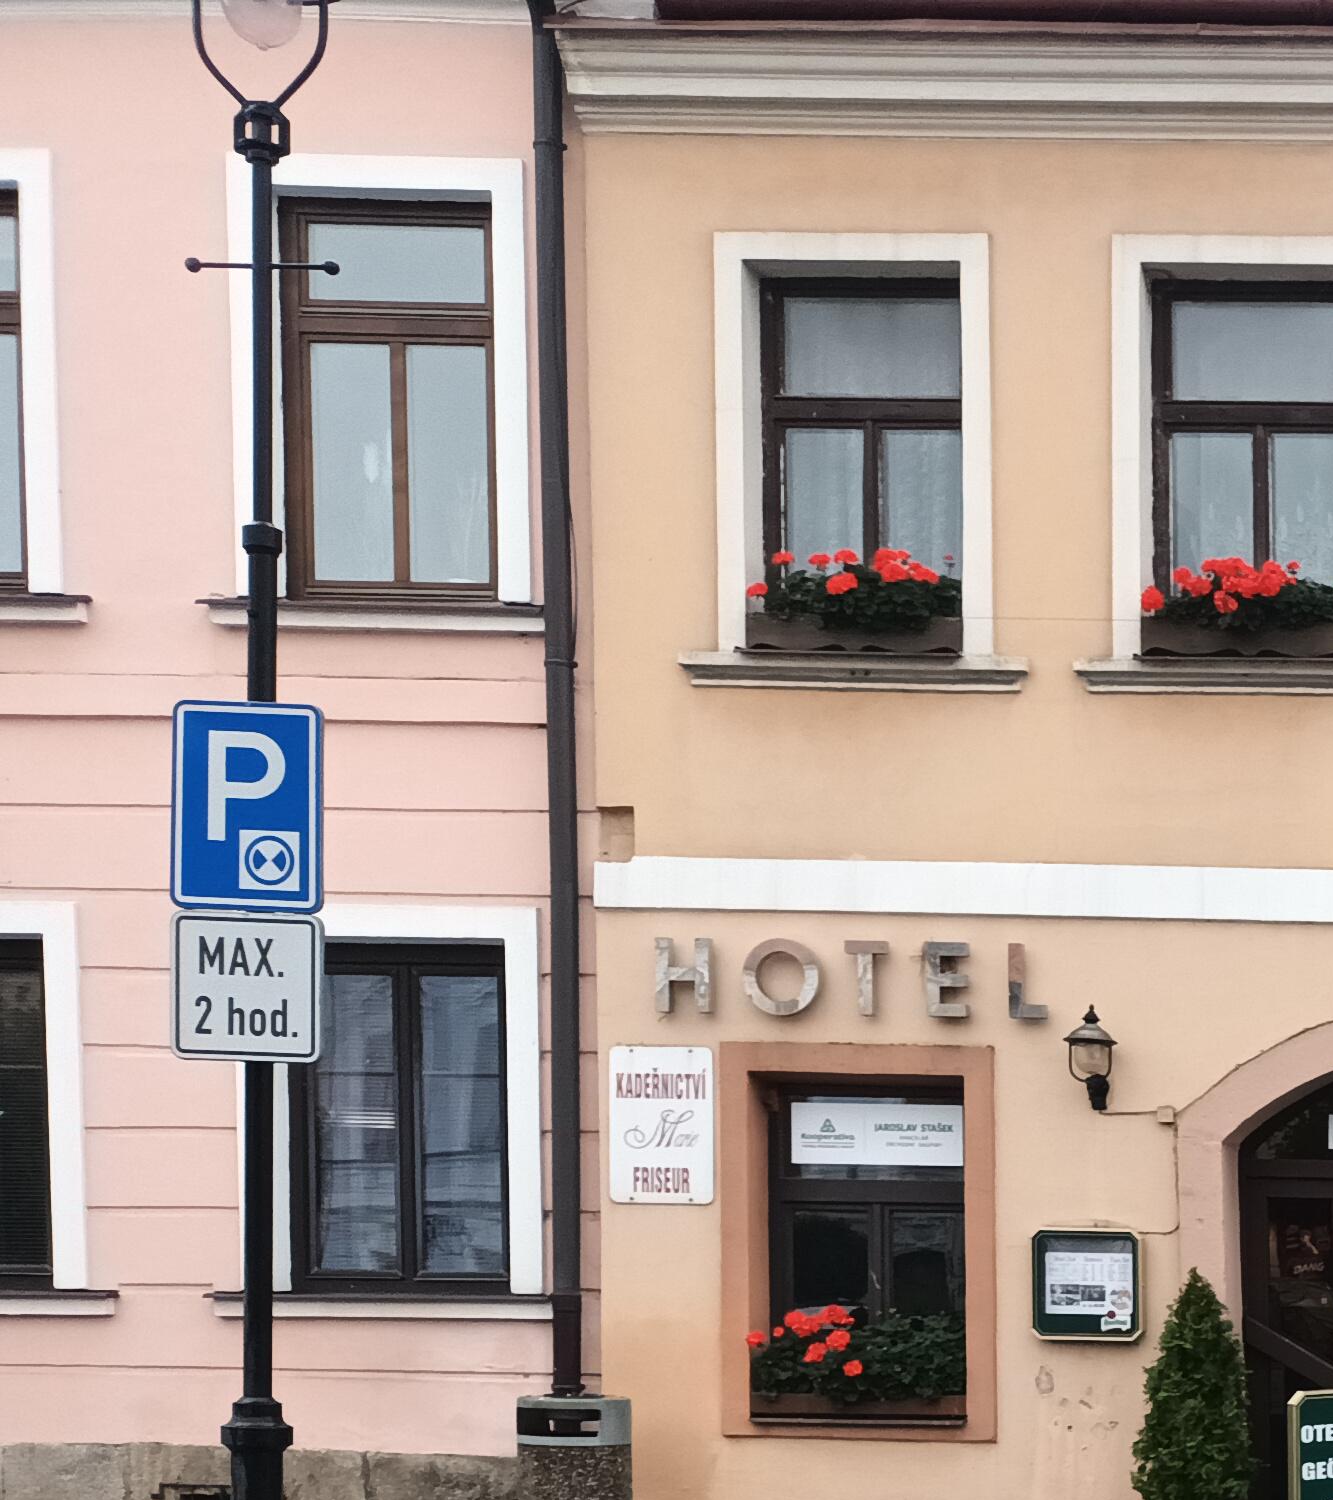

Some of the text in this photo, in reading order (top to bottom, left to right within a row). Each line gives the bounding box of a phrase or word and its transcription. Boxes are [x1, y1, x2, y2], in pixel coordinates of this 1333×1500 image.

[207, 729, 286, 841] P
[198, 935, 285, 978] MAX.
[654, 937, 1049, 1020] HOTEL
[194, 995, 299, 1039] 2 hod.
[615, 1067, 707, 1100] KADEŘNICTVÍ
[874, 1123, 917, 1132] JAROSLAV
[632, 1166, 691, 1194] FRISEUR
